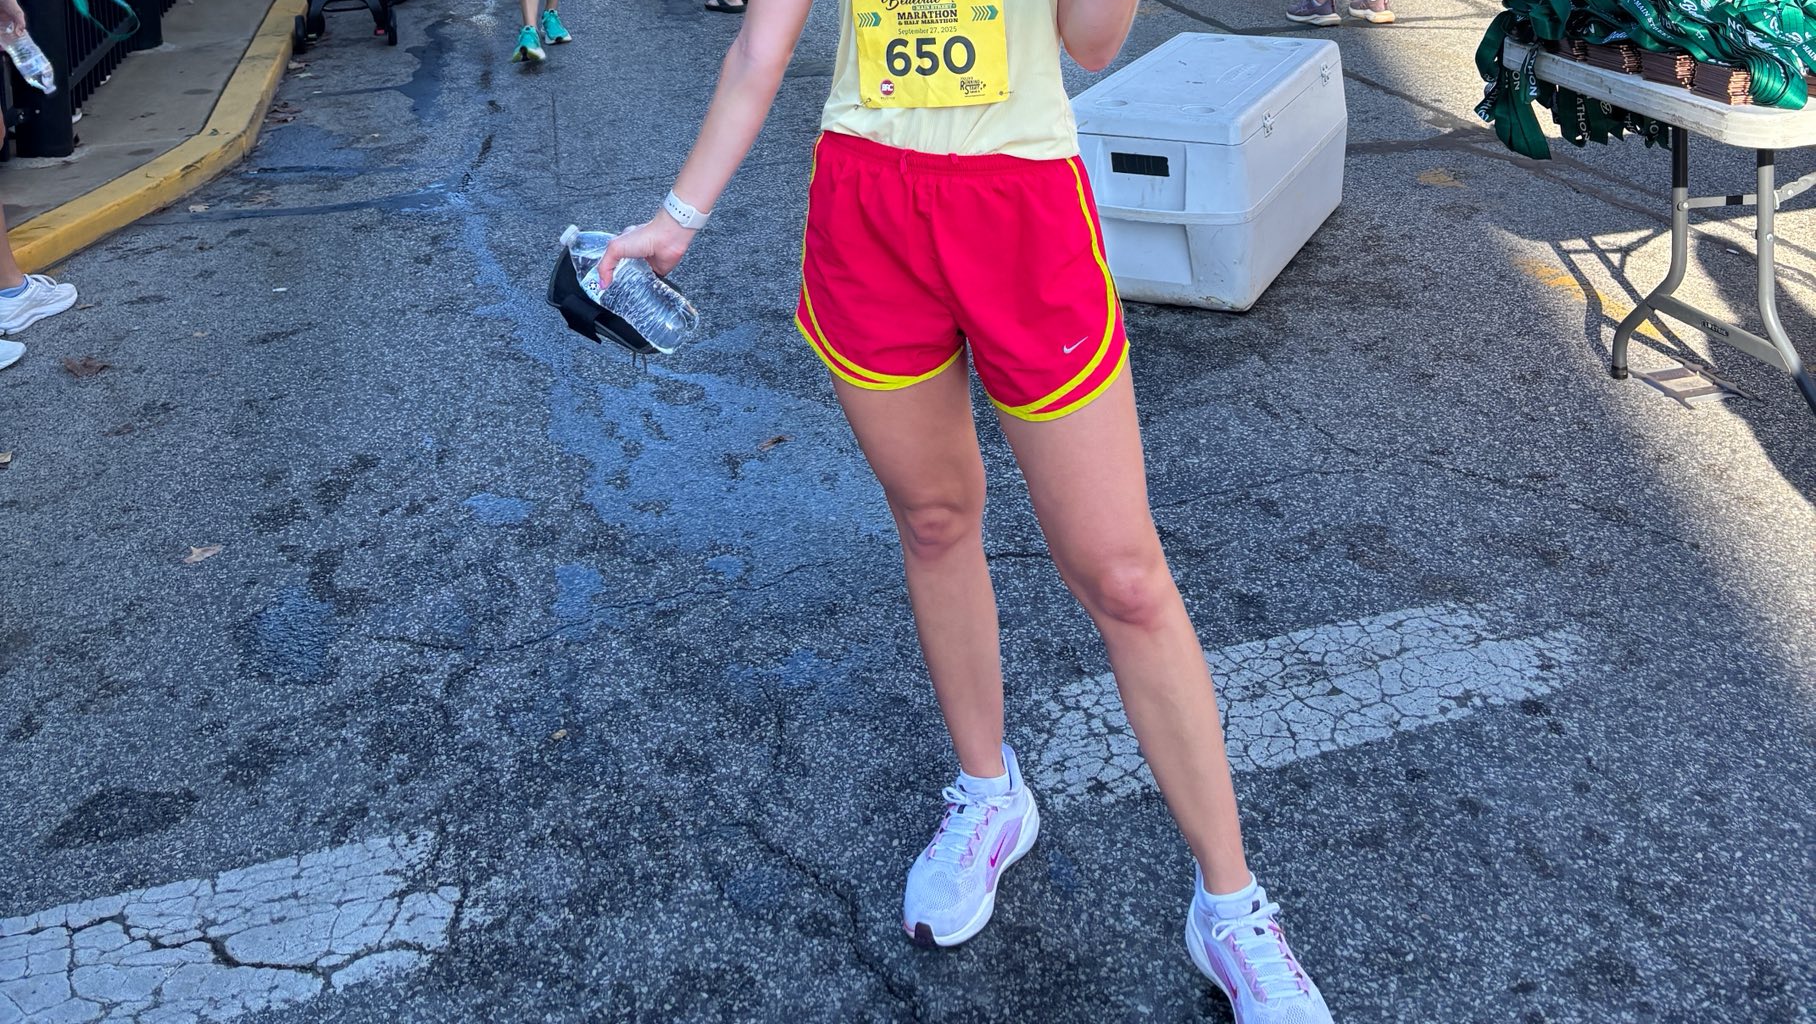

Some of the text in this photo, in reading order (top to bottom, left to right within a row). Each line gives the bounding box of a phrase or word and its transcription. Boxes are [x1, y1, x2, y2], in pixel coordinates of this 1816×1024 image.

[897, 10, 957, 20] MARATHON
[1634, 0, 1650, 16] MAIN
[886, 35, 976, 77] 650
